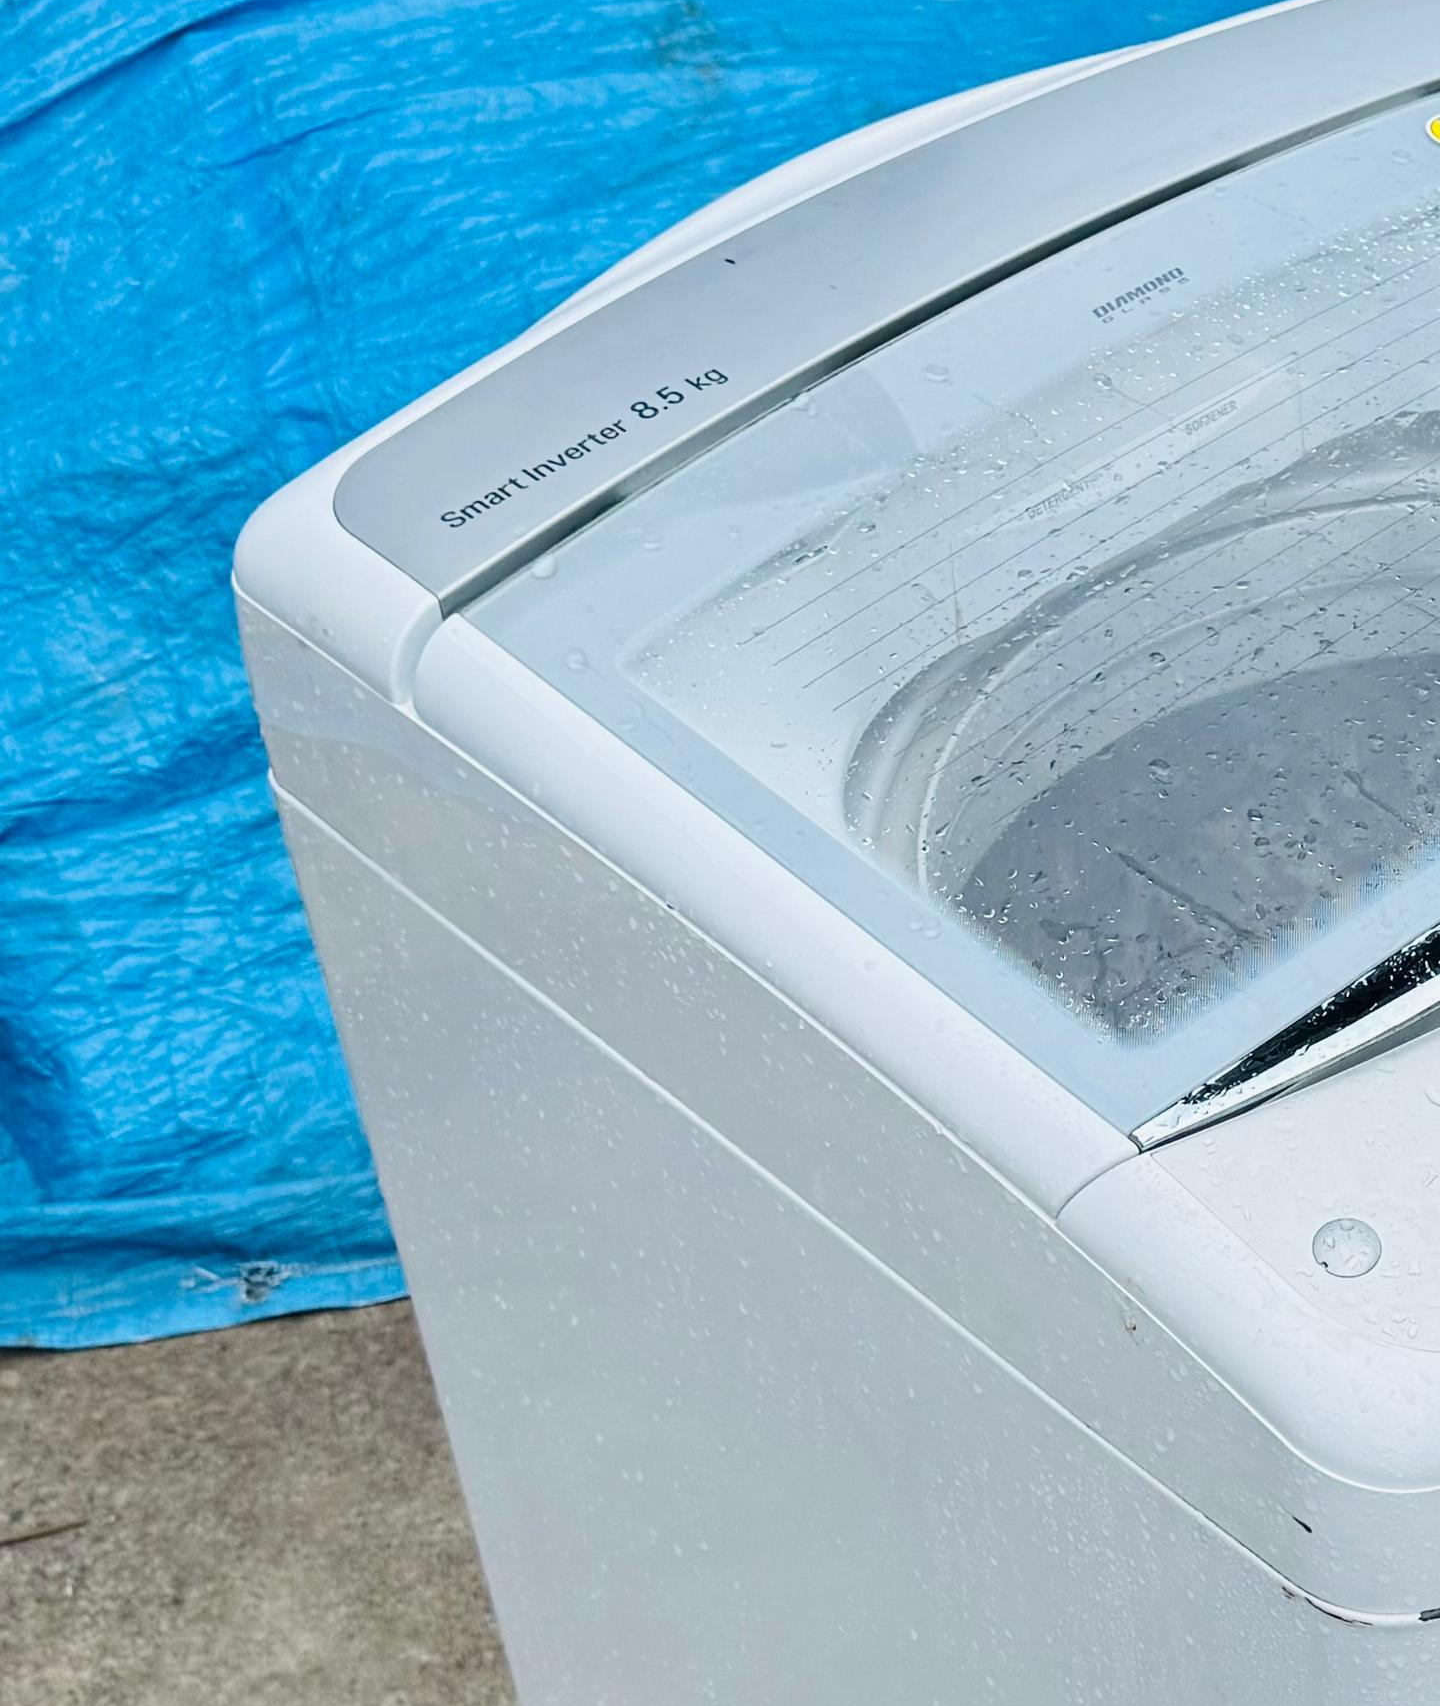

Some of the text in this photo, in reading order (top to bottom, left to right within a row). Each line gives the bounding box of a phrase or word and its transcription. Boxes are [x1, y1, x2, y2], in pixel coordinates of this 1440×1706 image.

[1092, 267, 1185, 319] DIAMOND
[441, 368, 729, 528] Smart Inverter 8.5 kg
